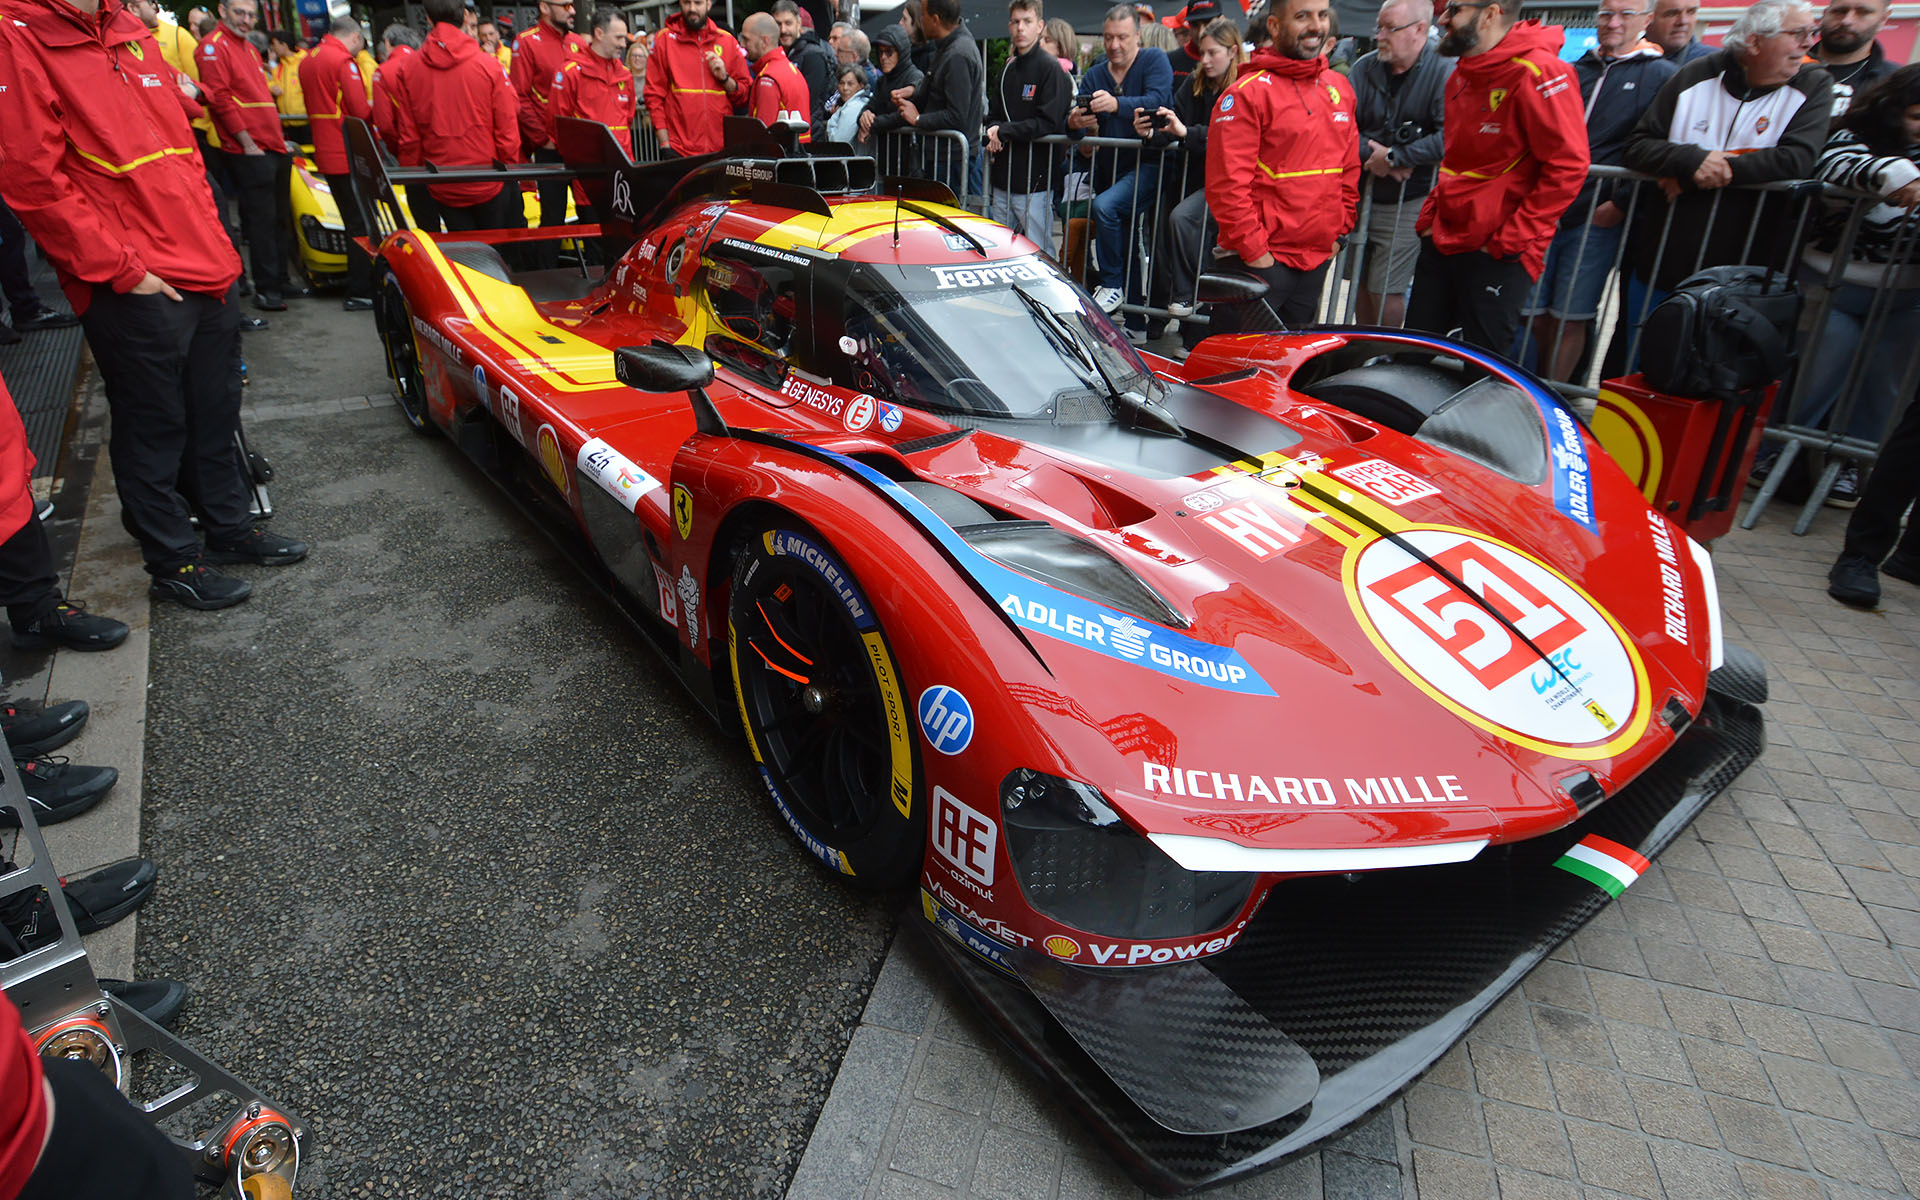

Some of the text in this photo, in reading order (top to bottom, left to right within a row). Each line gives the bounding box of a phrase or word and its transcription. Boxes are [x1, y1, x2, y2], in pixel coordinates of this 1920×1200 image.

[725, 164, 773, 181] ADLER GROUP
[929, 254, 1059, 290] Ferra
[413, 315, 462, 366] RICHARD MILLE
[788, 381, 844, 416] GENESYS
[1339, 461, 1401, 484] HYPER
[1364, 473, 1436, 501] CAR
[1554, 407, 1590, 524] ADLER GROUP
[1202, 501, 1302, 558] HY
[786, 536, 865, 619] MICHELIN
[1646, 509, 1688, 646] RICHARD MILLE
[1000, 593, 1247, 684] ADLER GROUP
[1391, 558, 1567, 671] 51
[870, 644, 902, 742] PILOT SPORT
[1531, 647, 1582, 695] WEC
[923, 686, 970, 751] hp
[1143, 761, 1469, 806] RICHARD MILLE
[763, 774, 825, 860] MICHELIN
[926, 872, 1034, 947] VISTAJET
[951, 870, 994, 903] azimut
[1089, 931, 1240, 964] V-Power
